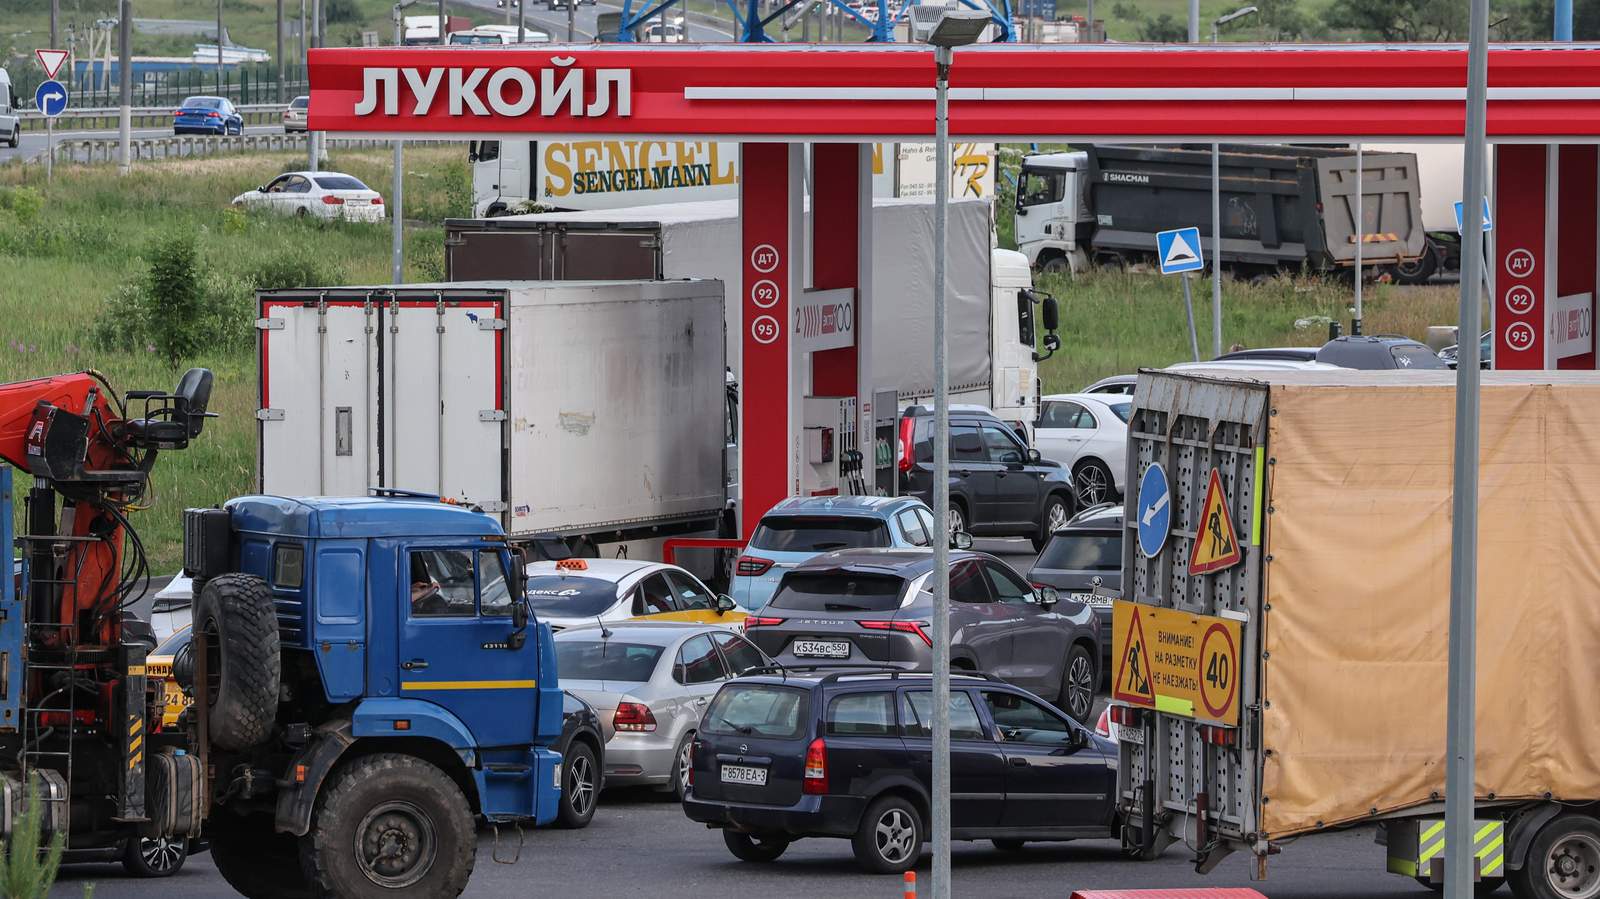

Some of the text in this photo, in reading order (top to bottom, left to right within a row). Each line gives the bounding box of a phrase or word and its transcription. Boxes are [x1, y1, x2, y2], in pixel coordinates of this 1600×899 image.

[354, 56, 632, 117] ЛУКОЙЛ
[573, 163, 712, 195] SENGELMANN
[1110, 174, 1149, 183] SHACMAN
[758, 253, 774, 265] ДТ
[1512, 258, 1528, 269] ДТ
[758, 289, 773, 300] 92
[1512, 294, 1528, 305] 92
[795, 307, 801, 334] 2
[758, 324, 773, 336] 95
[1512, 331, 1528, 342] 95
[1157, 631, 1196, 649] ВНИМАНИЕ!
[796, 642, 847, 653] К534ВС 550
[1154, 651, 1198, 671] НА РАЗМЕТКУ
[1206, 651, 1229, 690] 40
[1152, 671, 1199, 691] НЕ НАЕЗЖАТЬ!
